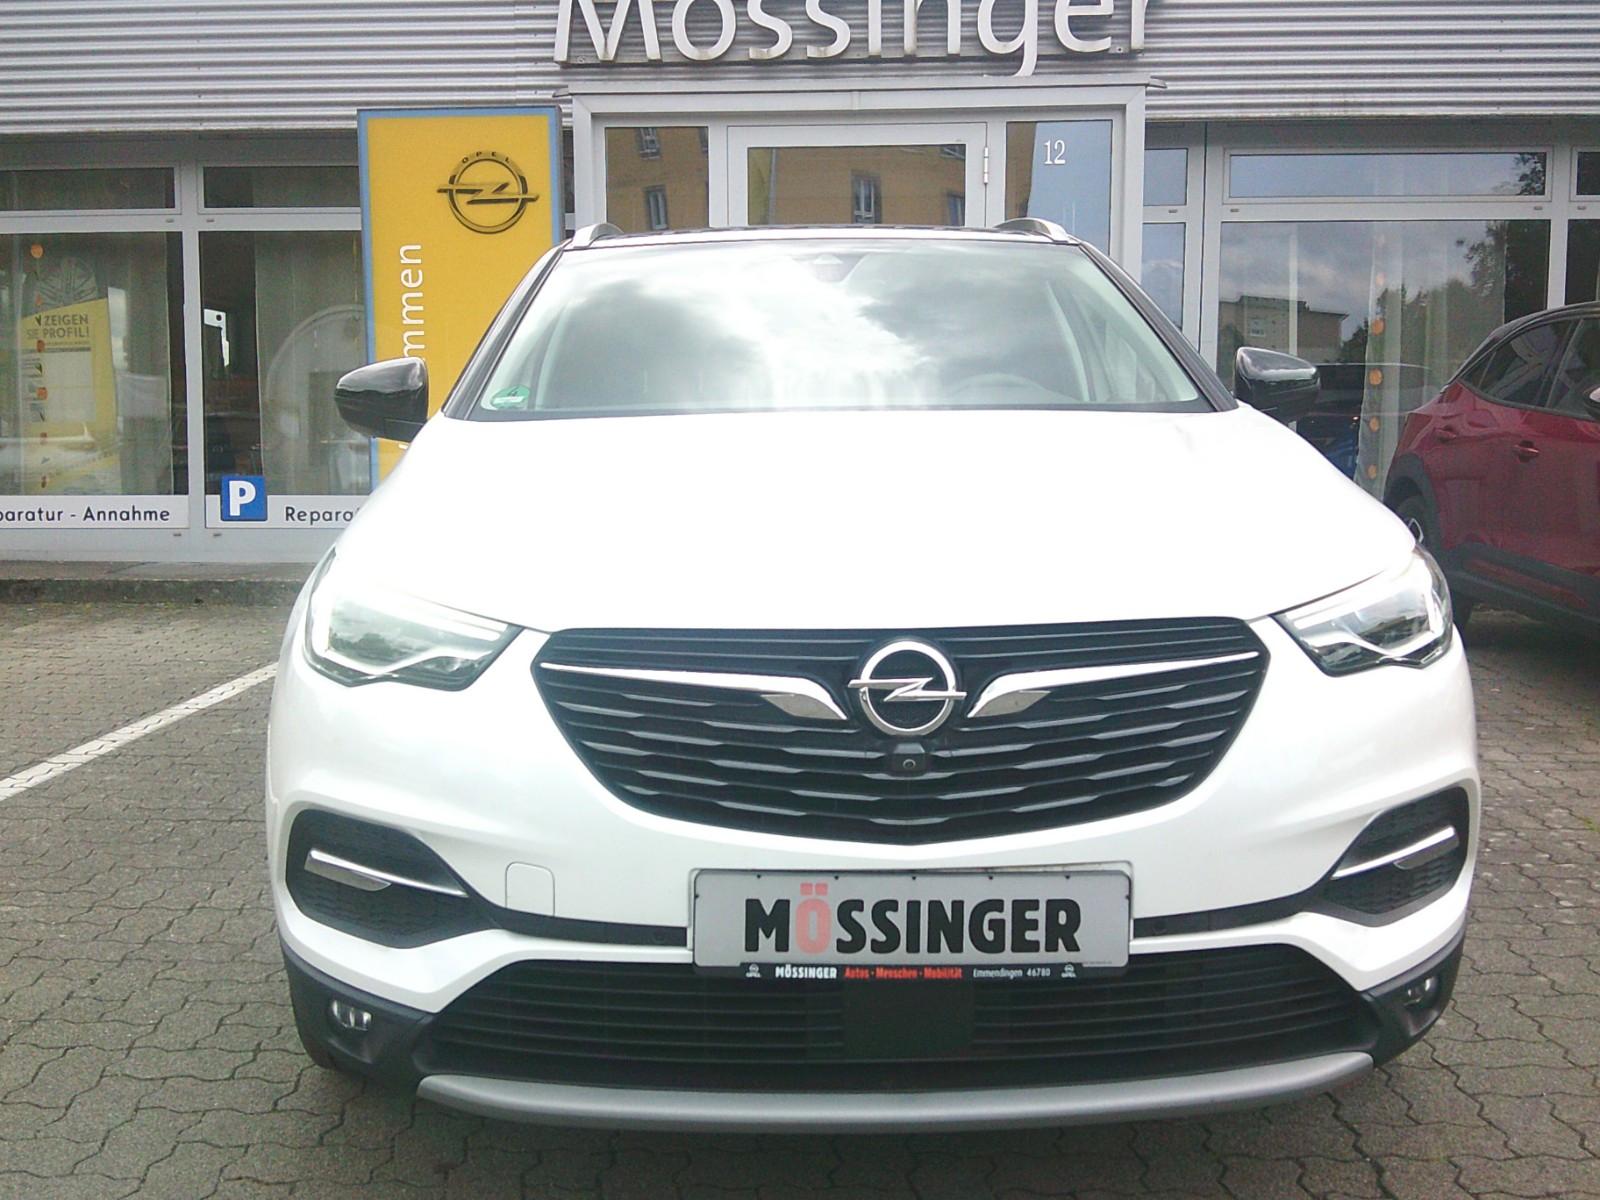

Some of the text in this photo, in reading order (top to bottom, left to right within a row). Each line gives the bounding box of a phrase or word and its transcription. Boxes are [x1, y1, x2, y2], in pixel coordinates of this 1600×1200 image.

[462, 151, 510, 164] OPEL
[1044, 139, 1066, 165] 12
[44, 314, 89, 326] ZEIGEN
[43, 326, 89, 339] PROFIL!
[229, 480, 256, 516] P
[83, 505, 170, 522] Annahme
[285, 506, 360, 525] Repara
[744, 882, 1081, 954] MÖSSINGER
[775, 964, 838, 979] MÖSSINGER
[973, 967, 1023, 980] Emmendingen
